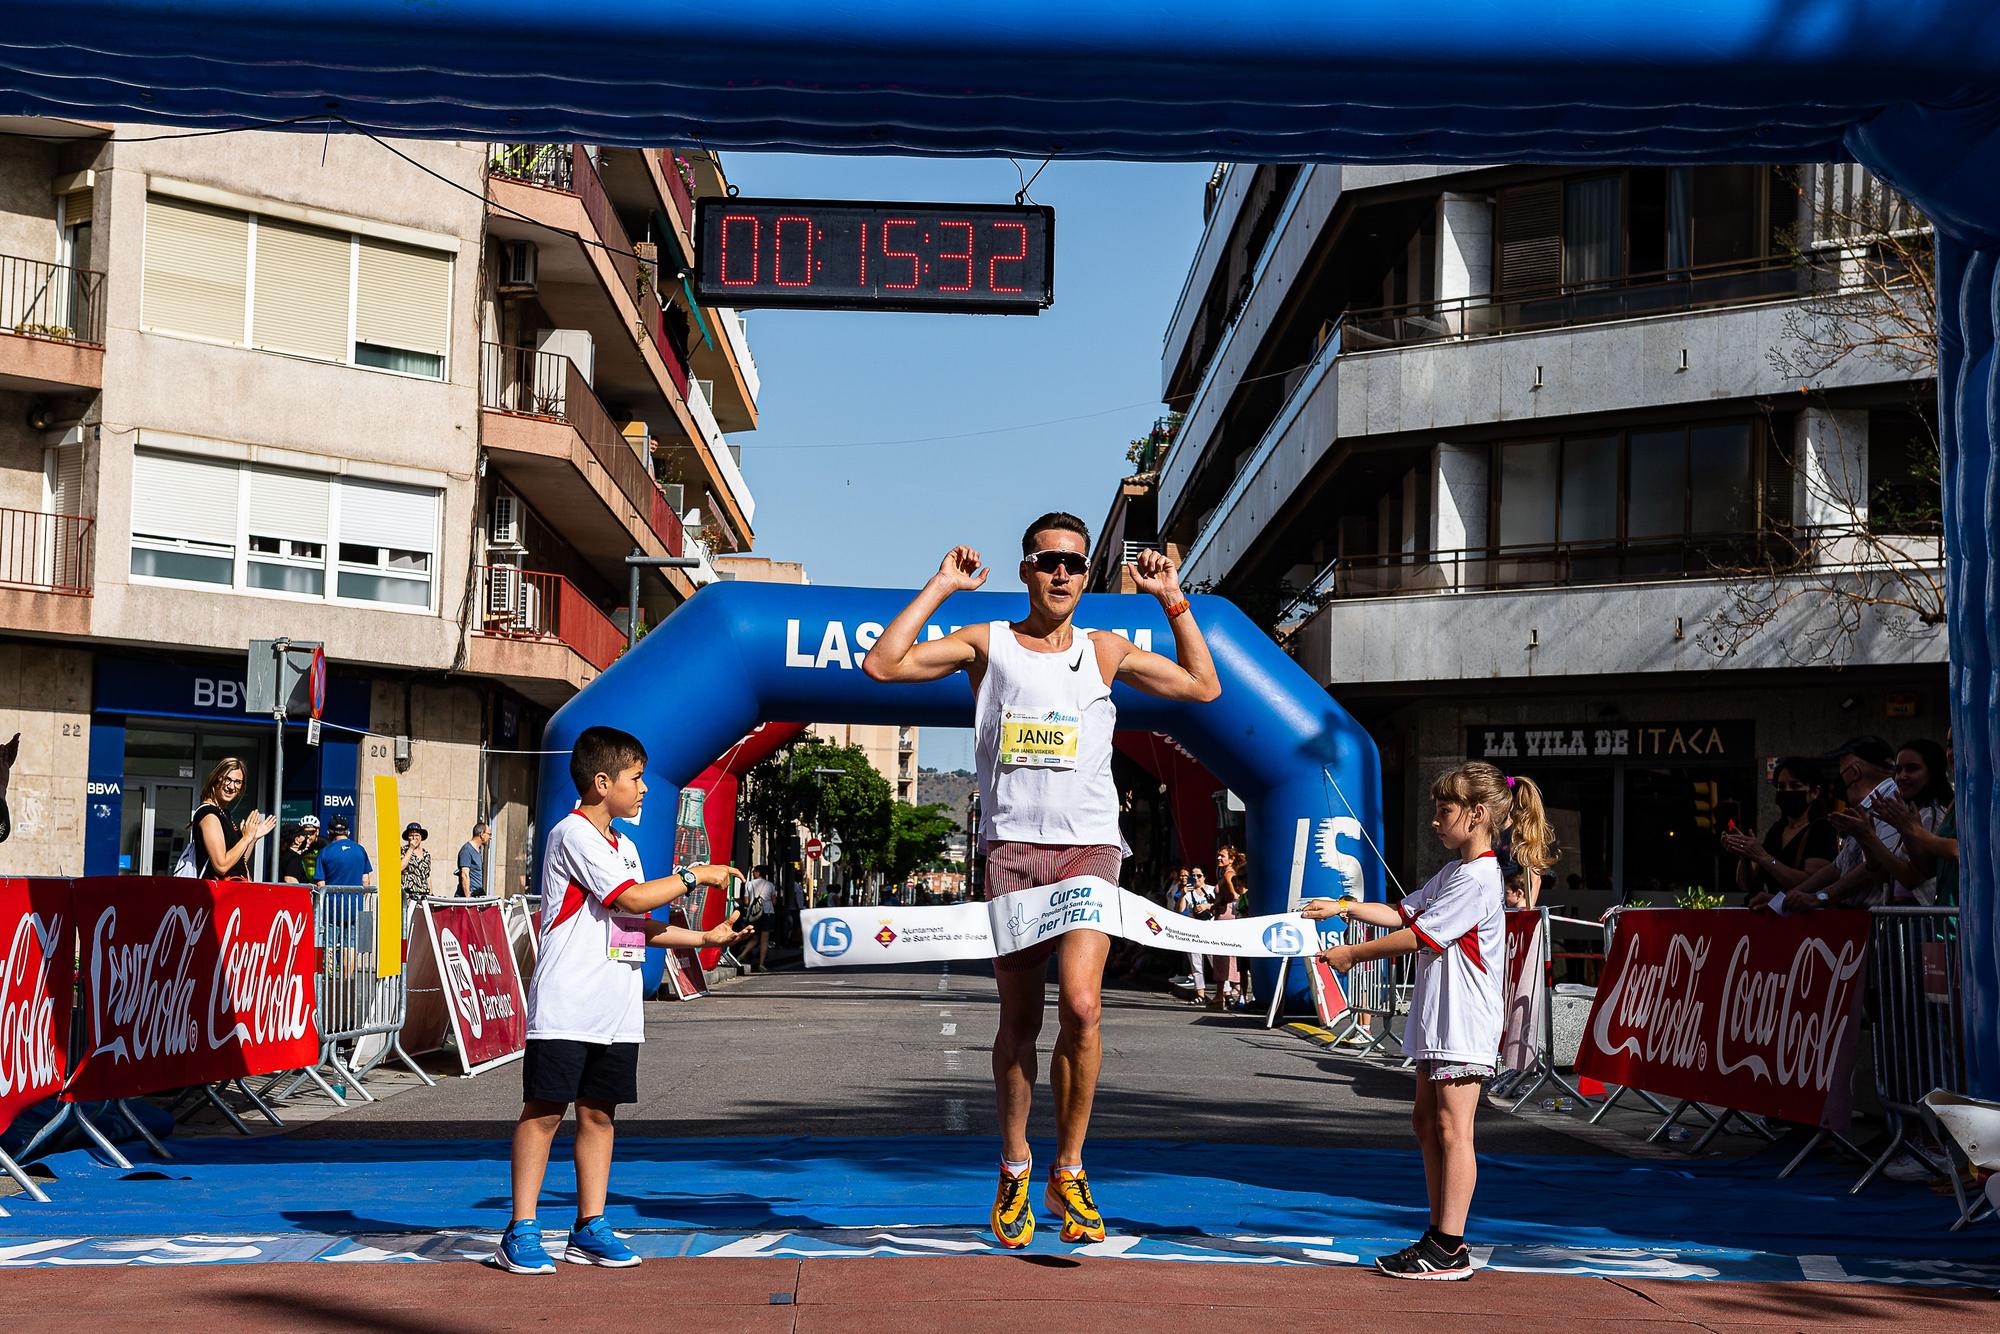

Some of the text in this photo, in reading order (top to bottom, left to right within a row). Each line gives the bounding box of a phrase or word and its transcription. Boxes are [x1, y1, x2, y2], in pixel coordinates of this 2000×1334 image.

[721, 216, 1027, 293] 00:15:32
[194, 678, 247, 708] BB
[62, 723, 81, 737] 22
[1016, 729, 1064, 745] JANIS
[1484, 727, 1725, 757] LA VILA DE ITACA
[371, 745, 387, 758] 20
[87, 782, 120, 795] BBVA
[324, 795, 354, 807] BBVA
[1050, 887, 1092, 907] Cursa
[1069, 901, 1083, 909] Sant
[1037, 908, 1100, 938] per l'ELA
